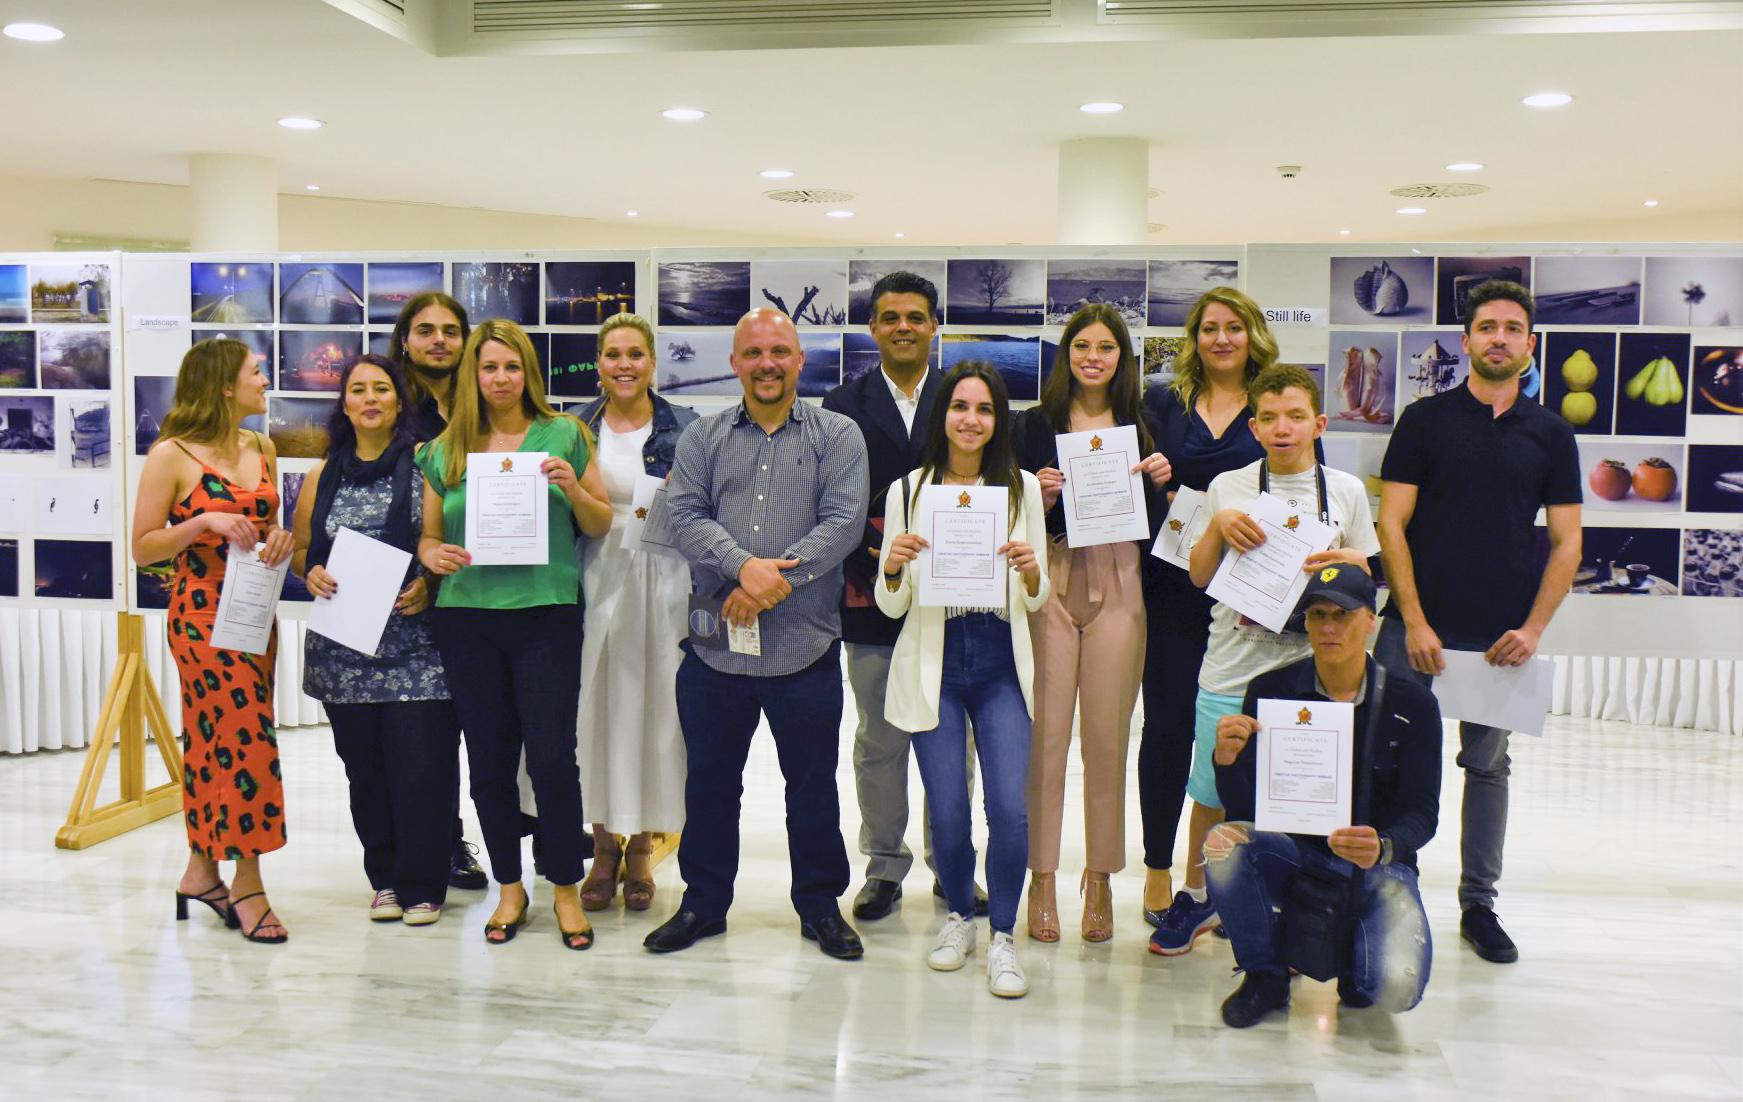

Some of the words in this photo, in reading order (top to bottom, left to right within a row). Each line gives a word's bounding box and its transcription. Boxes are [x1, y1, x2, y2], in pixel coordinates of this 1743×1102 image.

[140, 317, 179, 328] Landscape
[1266, 310, 1289, 322] Still
[1293, 310, 1311, 323] life
